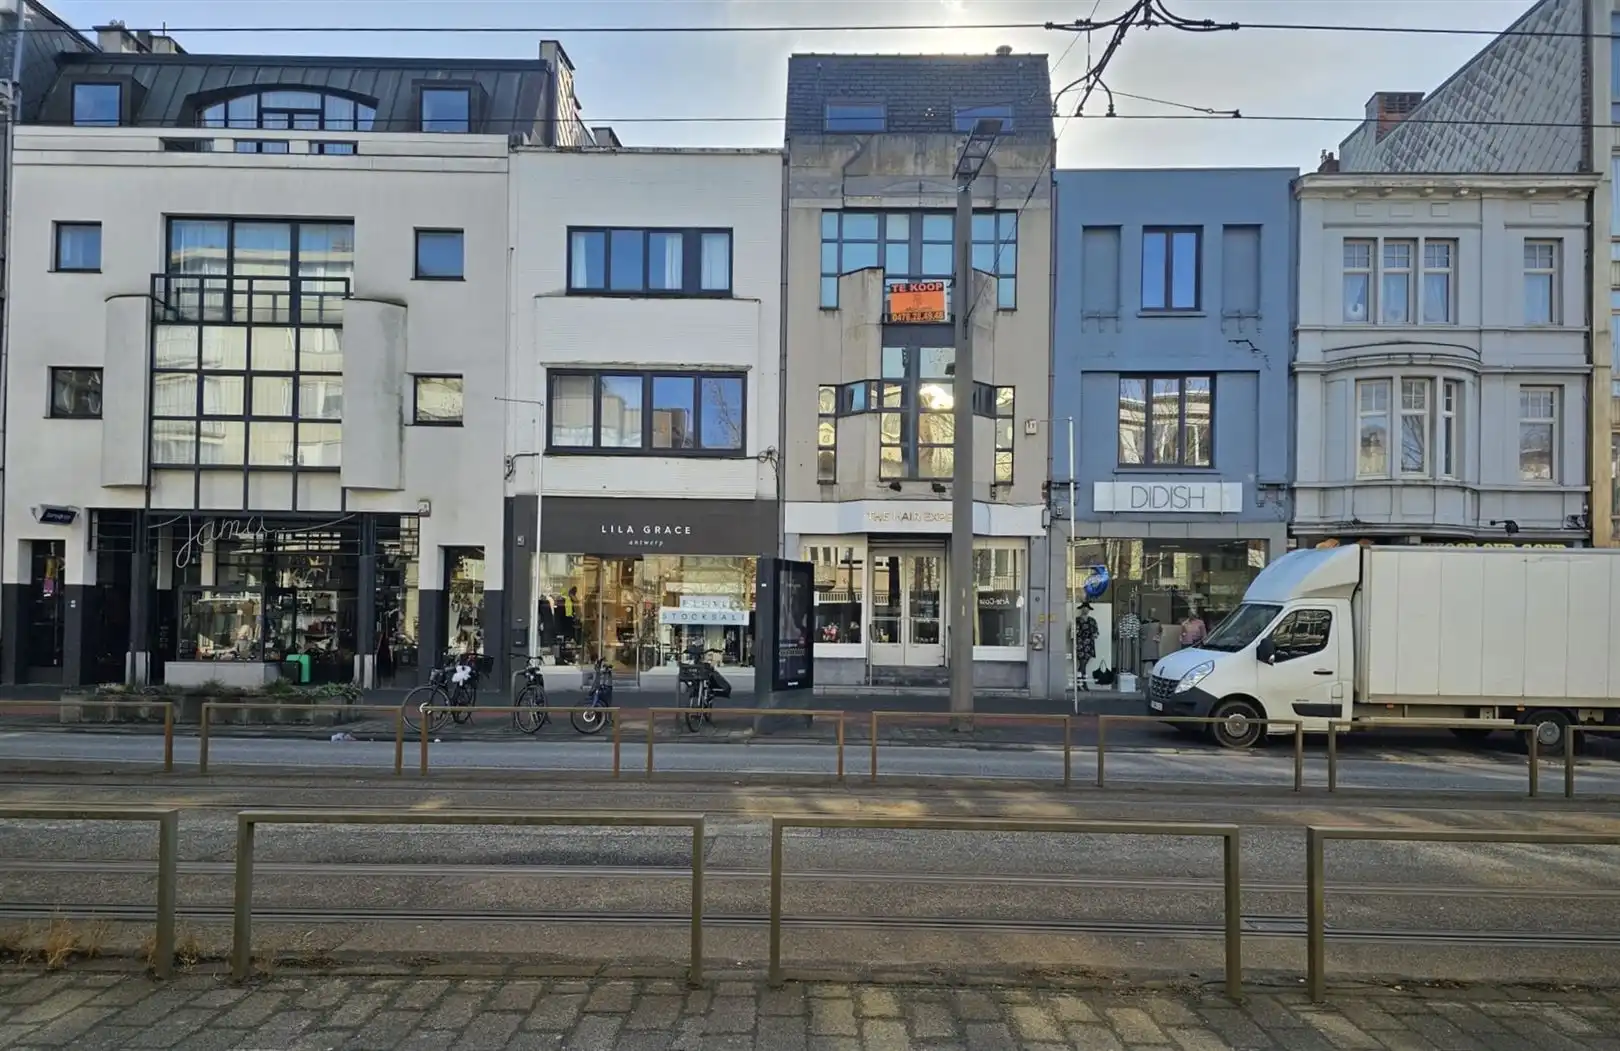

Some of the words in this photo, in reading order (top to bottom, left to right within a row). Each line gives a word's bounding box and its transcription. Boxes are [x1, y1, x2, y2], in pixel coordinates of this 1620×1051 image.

[891, 284, 905, 293] TE
[910, 282, 943, 292] KOOP
[1131, 485, 1205, 509] DIDISH
[923, 511, 951, 523] EXPE
[601, 525, 634, 534] LILA
[643, 525, 691, 535] GRACE
[628, 540, 664, 548] antwerp
